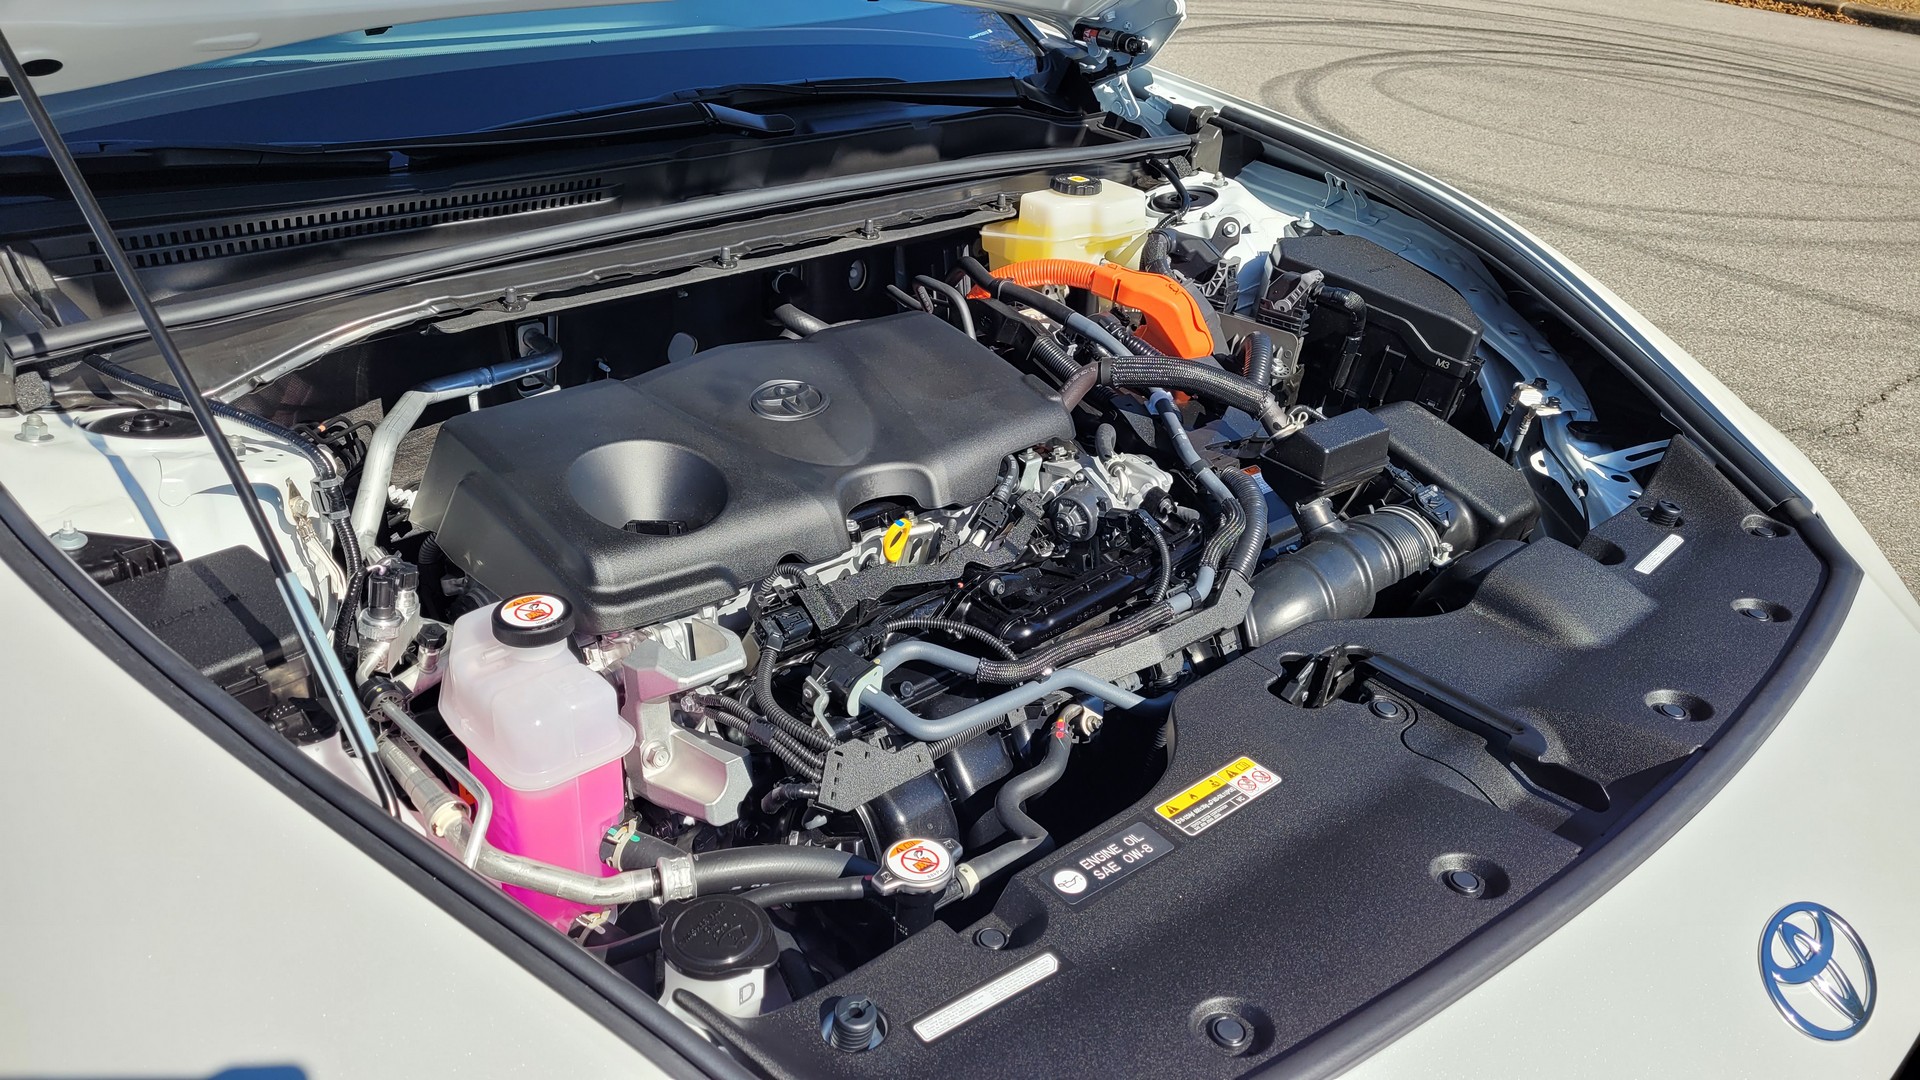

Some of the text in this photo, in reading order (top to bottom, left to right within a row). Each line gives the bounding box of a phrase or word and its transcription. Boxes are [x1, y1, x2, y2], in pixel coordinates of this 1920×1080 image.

[1435, 357, 1451, 369] M3
[1079, 833, 1145, 871] ENGINE OIL
[1093, 843, 1154, 880] SAE 0W-8
